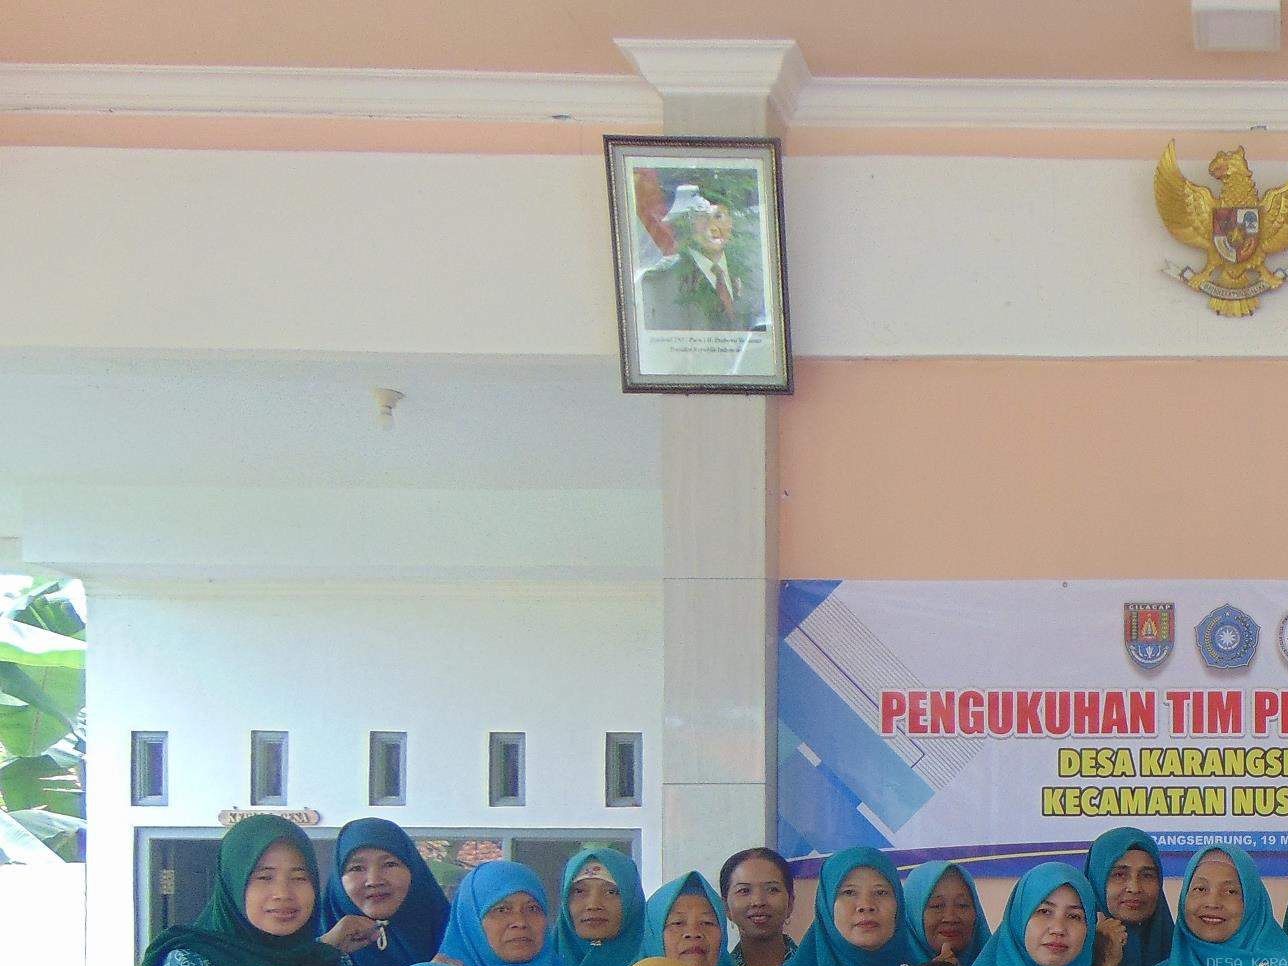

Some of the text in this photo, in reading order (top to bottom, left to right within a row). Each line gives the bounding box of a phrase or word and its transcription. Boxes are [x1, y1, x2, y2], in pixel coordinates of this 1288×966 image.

[880, 689, 1157, 736] PENGUKUHAN
[1165, 689, 1243, 736] TIM
[1057, 747, 1135, 778] DESA
[1041, 786, 1227, 817] KECAMATAN
[1150, 835, 1257, 847] ANGSEMBUNG,
[1260, 835, 1276, 846] 19
